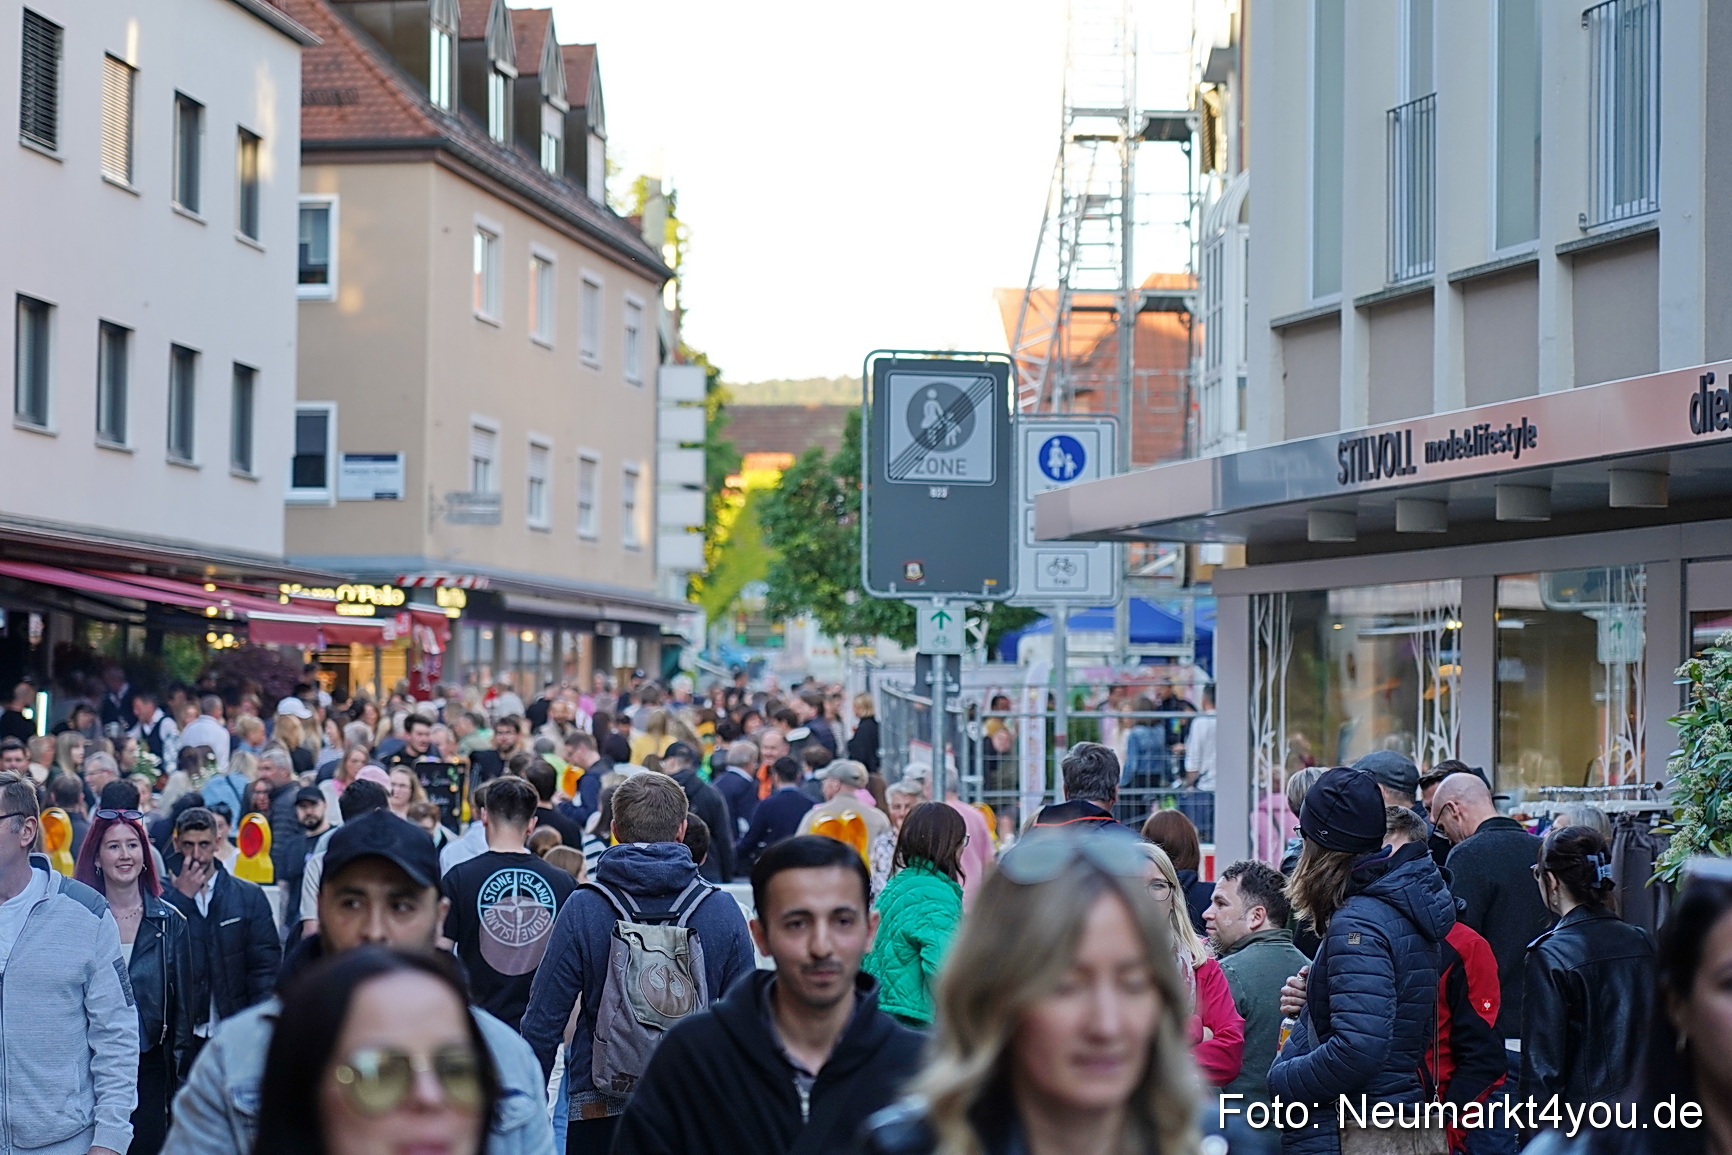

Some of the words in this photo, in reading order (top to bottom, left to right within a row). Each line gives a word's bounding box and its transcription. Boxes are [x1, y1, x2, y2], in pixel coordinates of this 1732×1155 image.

[1690, 372, 1732, 435] die
[915, 457, 966, 475] ZONE
[1338, 429, 1417, 485] STILVOLL
[1425, 417, 1537, 463] mode&lifestyle
[484, 873, 513, 902] STONE
[520, 873, 551, 904] ISLAND
[484, 909, 515, 941] ISLAND
[522, 909, 550, 940] STONE
